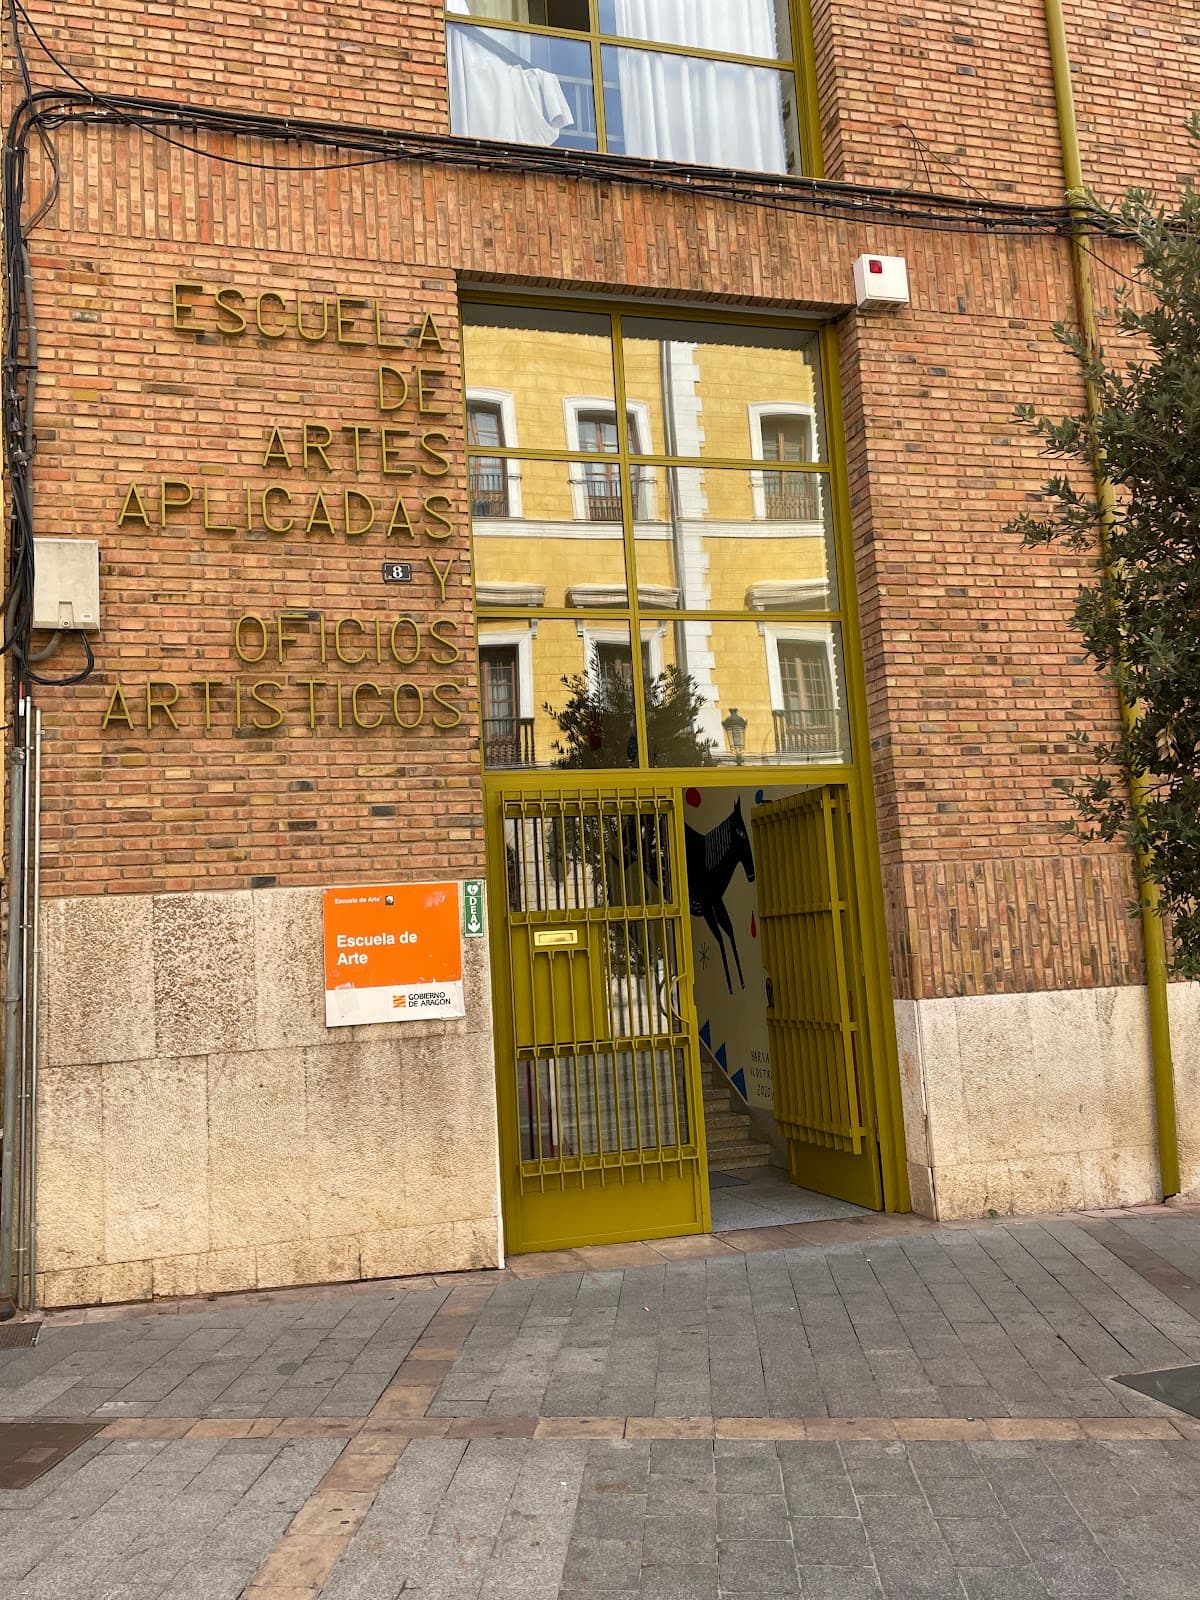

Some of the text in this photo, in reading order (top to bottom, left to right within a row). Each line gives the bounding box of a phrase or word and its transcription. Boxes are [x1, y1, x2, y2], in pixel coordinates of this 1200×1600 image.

[172, 282, 445, 353] ESCUELA
[378, 365, 450, 416] DE
[262, 422, 451, 478] ARTES
[117, 479, 454, 540] APLICADAS
[392, 565, 403, 578] 8
[427, 555, 454, 602] Y
[234, 613, 461, 666] OFICIOS
[102, 679, 463, 731] ARTISTICOS
[469, 896, 478, 923] DEA
[336, 931, 418, 948] Escuela de
[336, 952, 369, 966] Arte
[408, 991, 446, 1001] GOBIERNO
